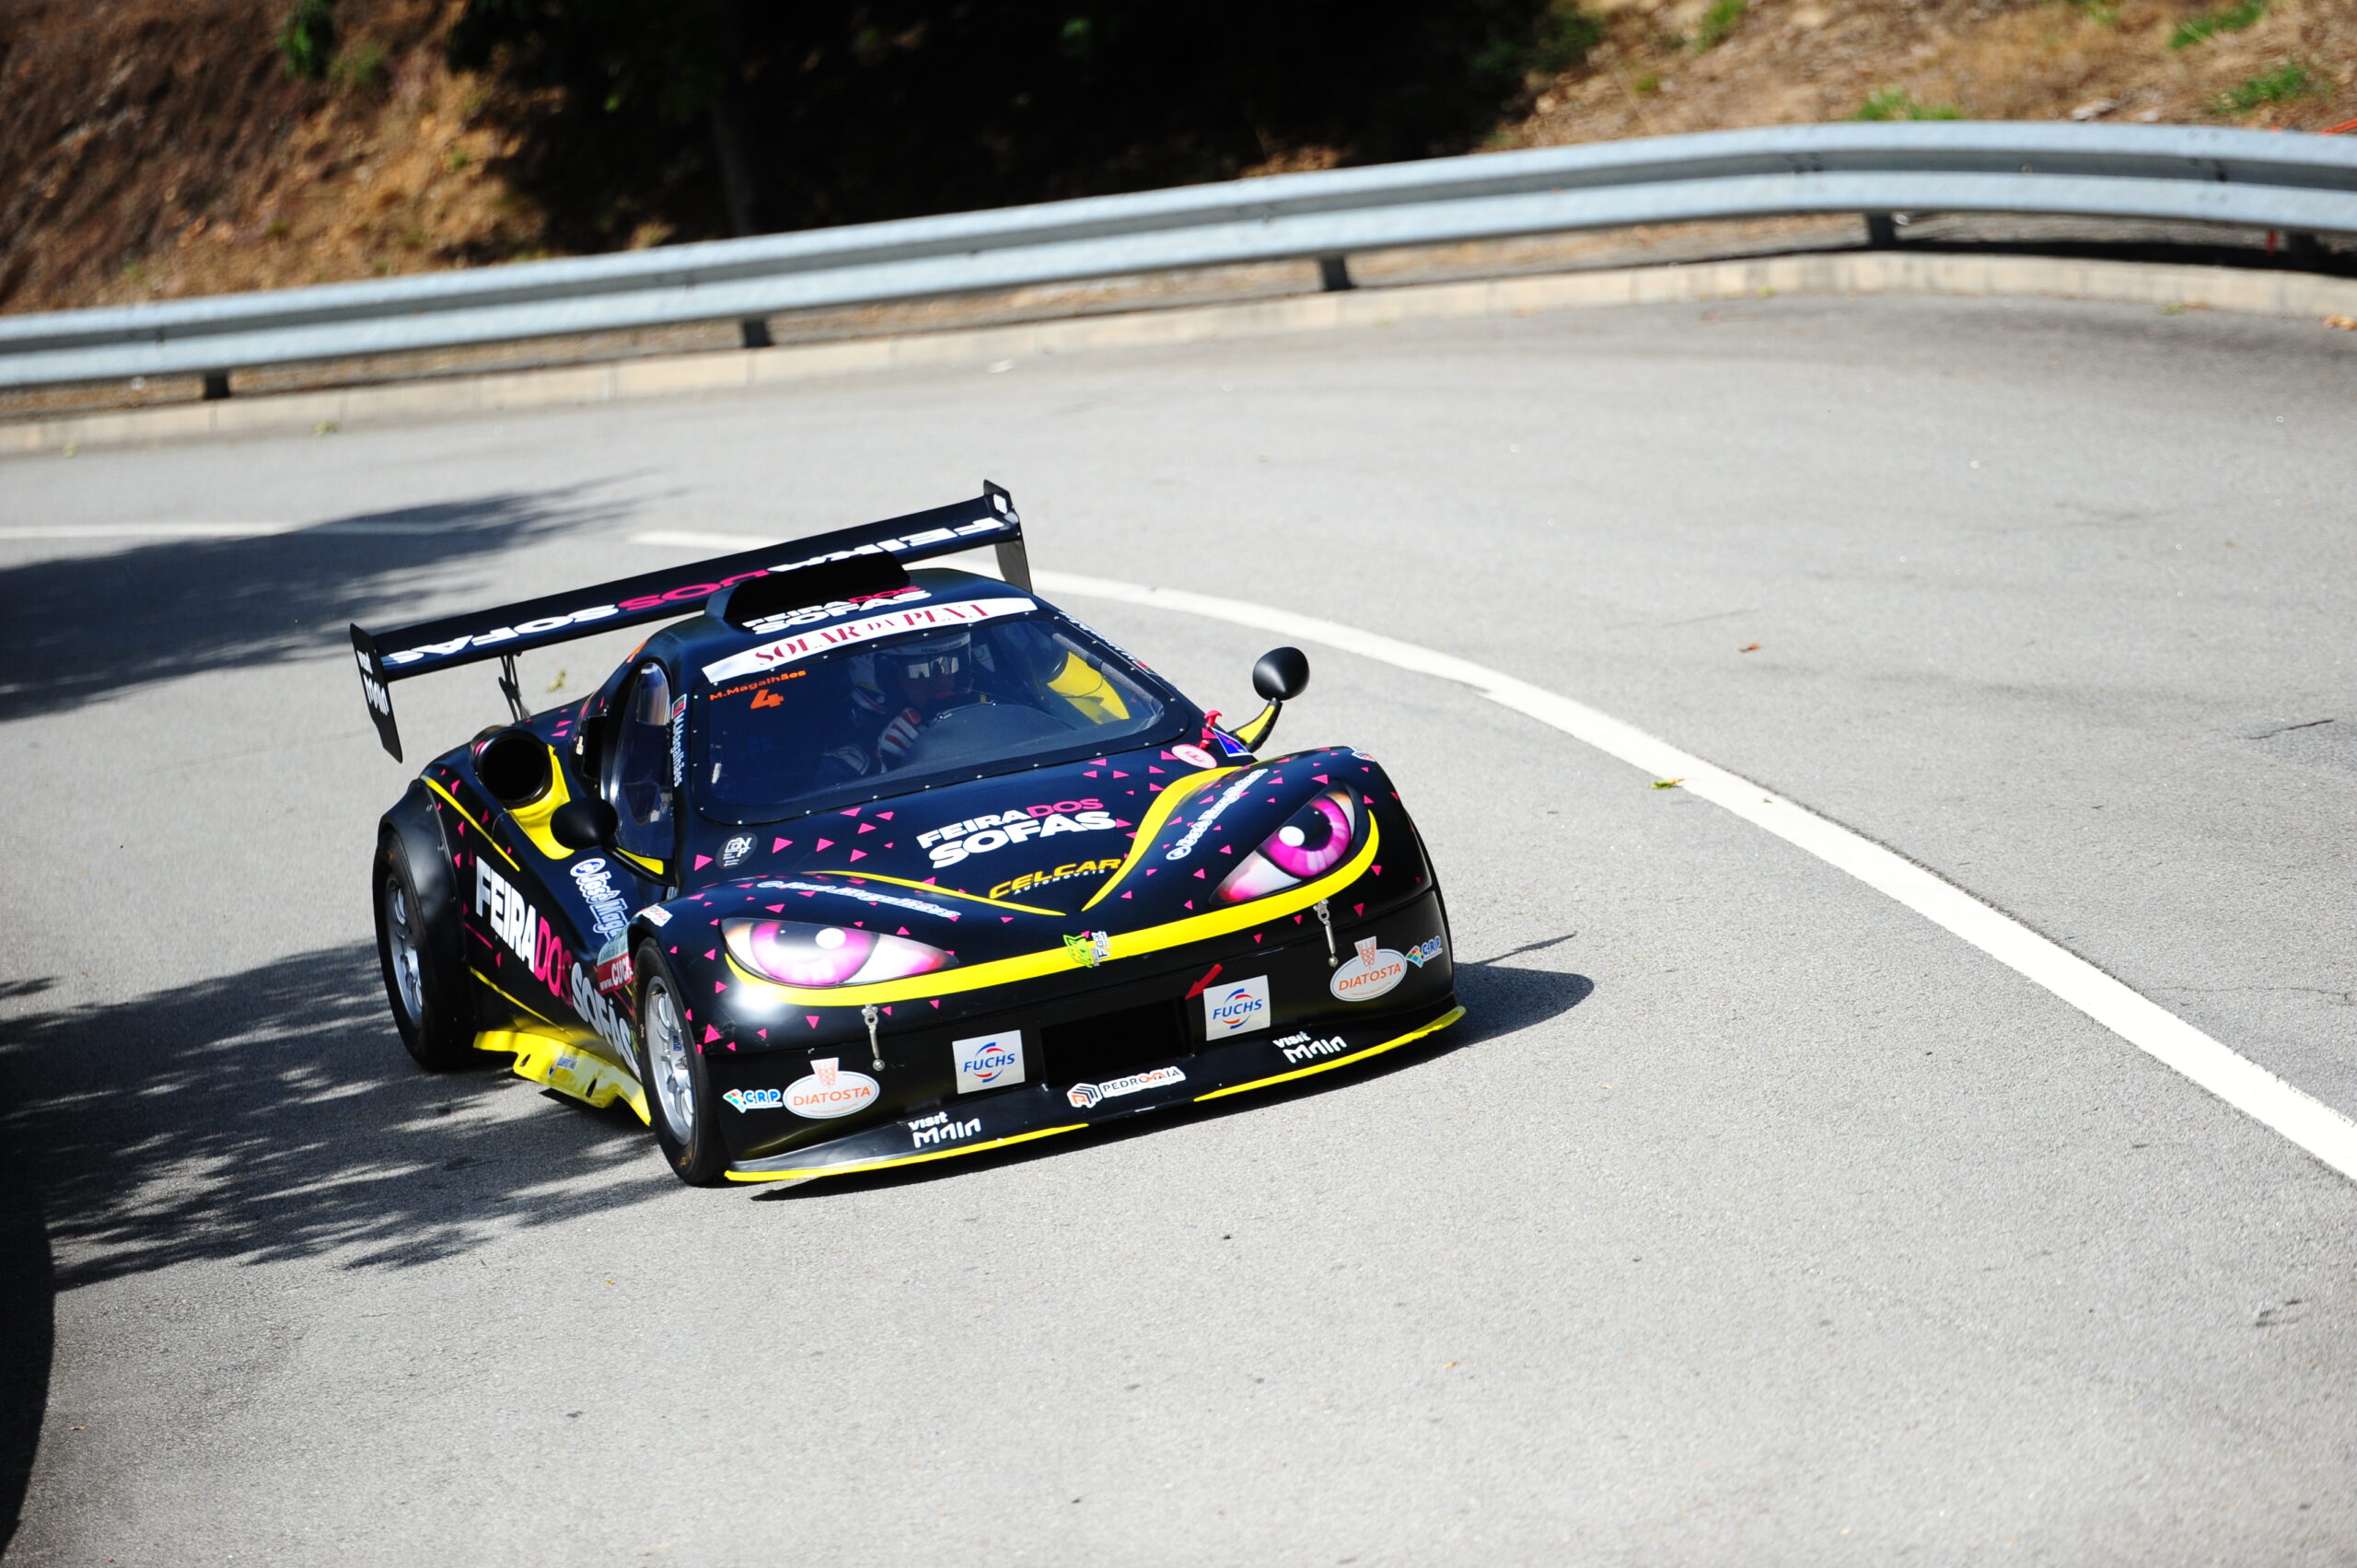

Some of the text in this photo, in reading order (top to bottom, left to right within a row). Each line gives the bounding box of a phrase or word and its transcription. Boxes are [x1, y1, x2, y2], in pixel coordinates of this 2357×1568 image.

[750, 689, 784, 709] 4
[988, 858, 1121, 900] CELCAR
[1338, 962, 1402, 992] DIATOSTA
[1212, 999, 1262, 1020] FUCHS
[963, 1053, 1016, 1073] FUCHS
[793, 1086, 872, 1106] DIATOSTA
